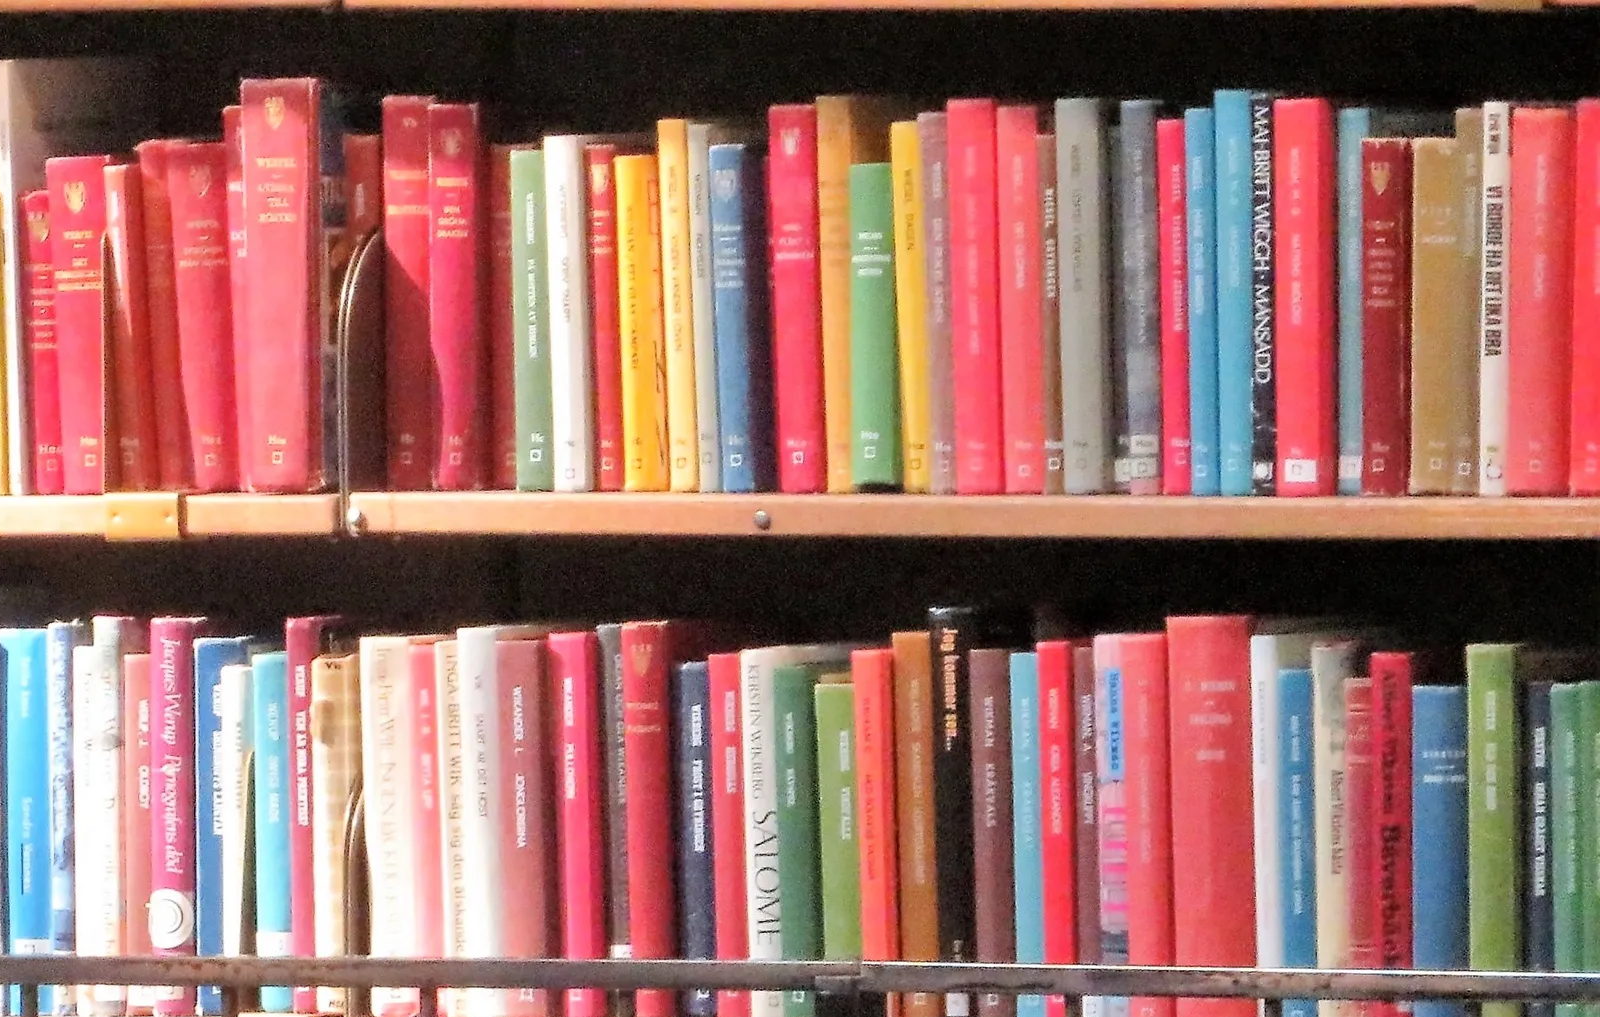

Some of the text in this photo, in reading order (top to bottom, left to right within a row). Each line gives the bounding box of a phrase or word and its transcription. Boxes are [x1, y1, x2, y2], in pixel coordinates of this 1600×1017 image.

[1486, 186, 1502, 200] VI
[1485, 203, 1502, 247] BORDE
[1485, 250, 1502, 268] HA
[1485, 298, 1502, 326] LIKA
[1485, 329, 1502, 357] BRA
[751, 810, 781, 946] SALOME
